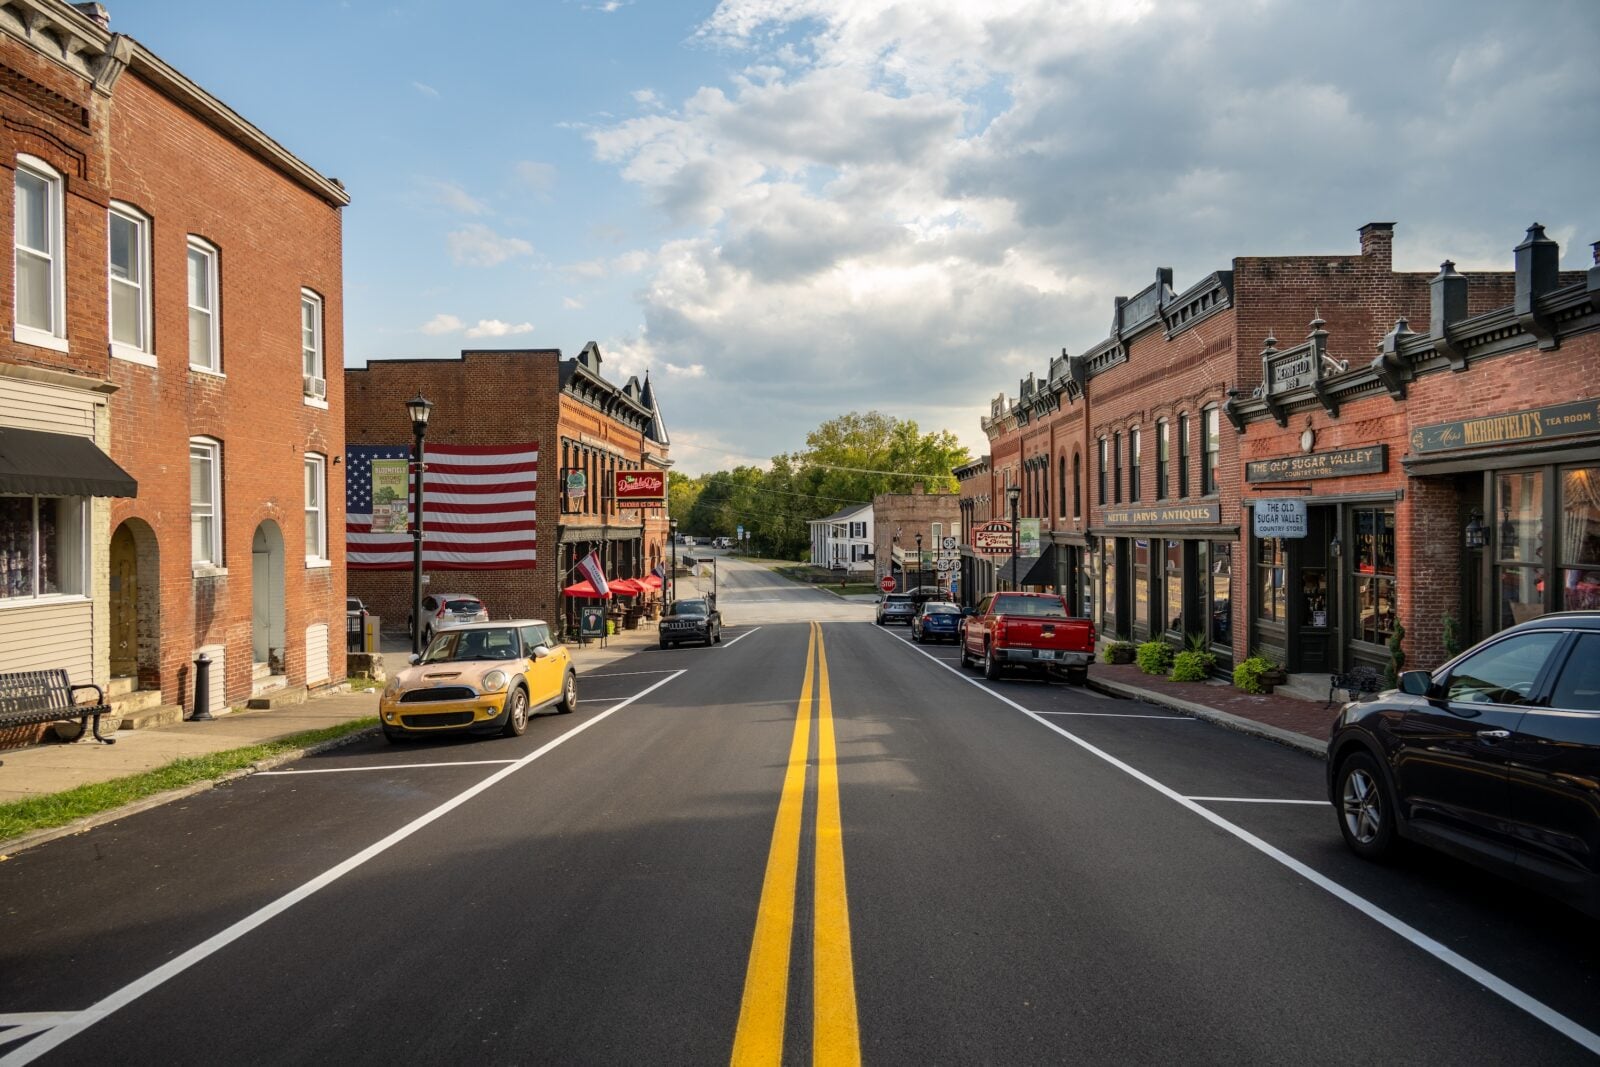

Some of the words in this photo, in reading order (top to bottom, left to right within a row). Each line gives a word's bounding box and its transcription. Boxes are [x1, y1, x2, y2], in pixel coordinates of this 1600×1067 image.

[1464, 412, 1542, 444] MERRIFIELD'S
[1545, 416, 1562, 426] TEA
[1563, 412, 1591, 424] ROOM
[1253, 462, 1267, 473] THE
[1270, 460, 1288, 472] OLD
[1291, 456, 1326, 470] SUGAR
[1330, 450, 1373, 464] VALLEY
[1285, 470, 1311, 478] COUNTRY
[1312, 467, 1333, 475] STORE
[644, 477, 662, 491] Dip
[1267, 504, 1279, 512] THE
[1281, 503, 1295, 512] OLD
[1133, 511, 1158, 523] JARVIS
[1161, 508, 1210, 521] ANTIQUES
[1257, 514, 1279, 523] SUGAR
[1281, 514, 1304, 523] VALLEY
[938, 561, 948, 569] 62
[951, 561, 960, 569] 48
